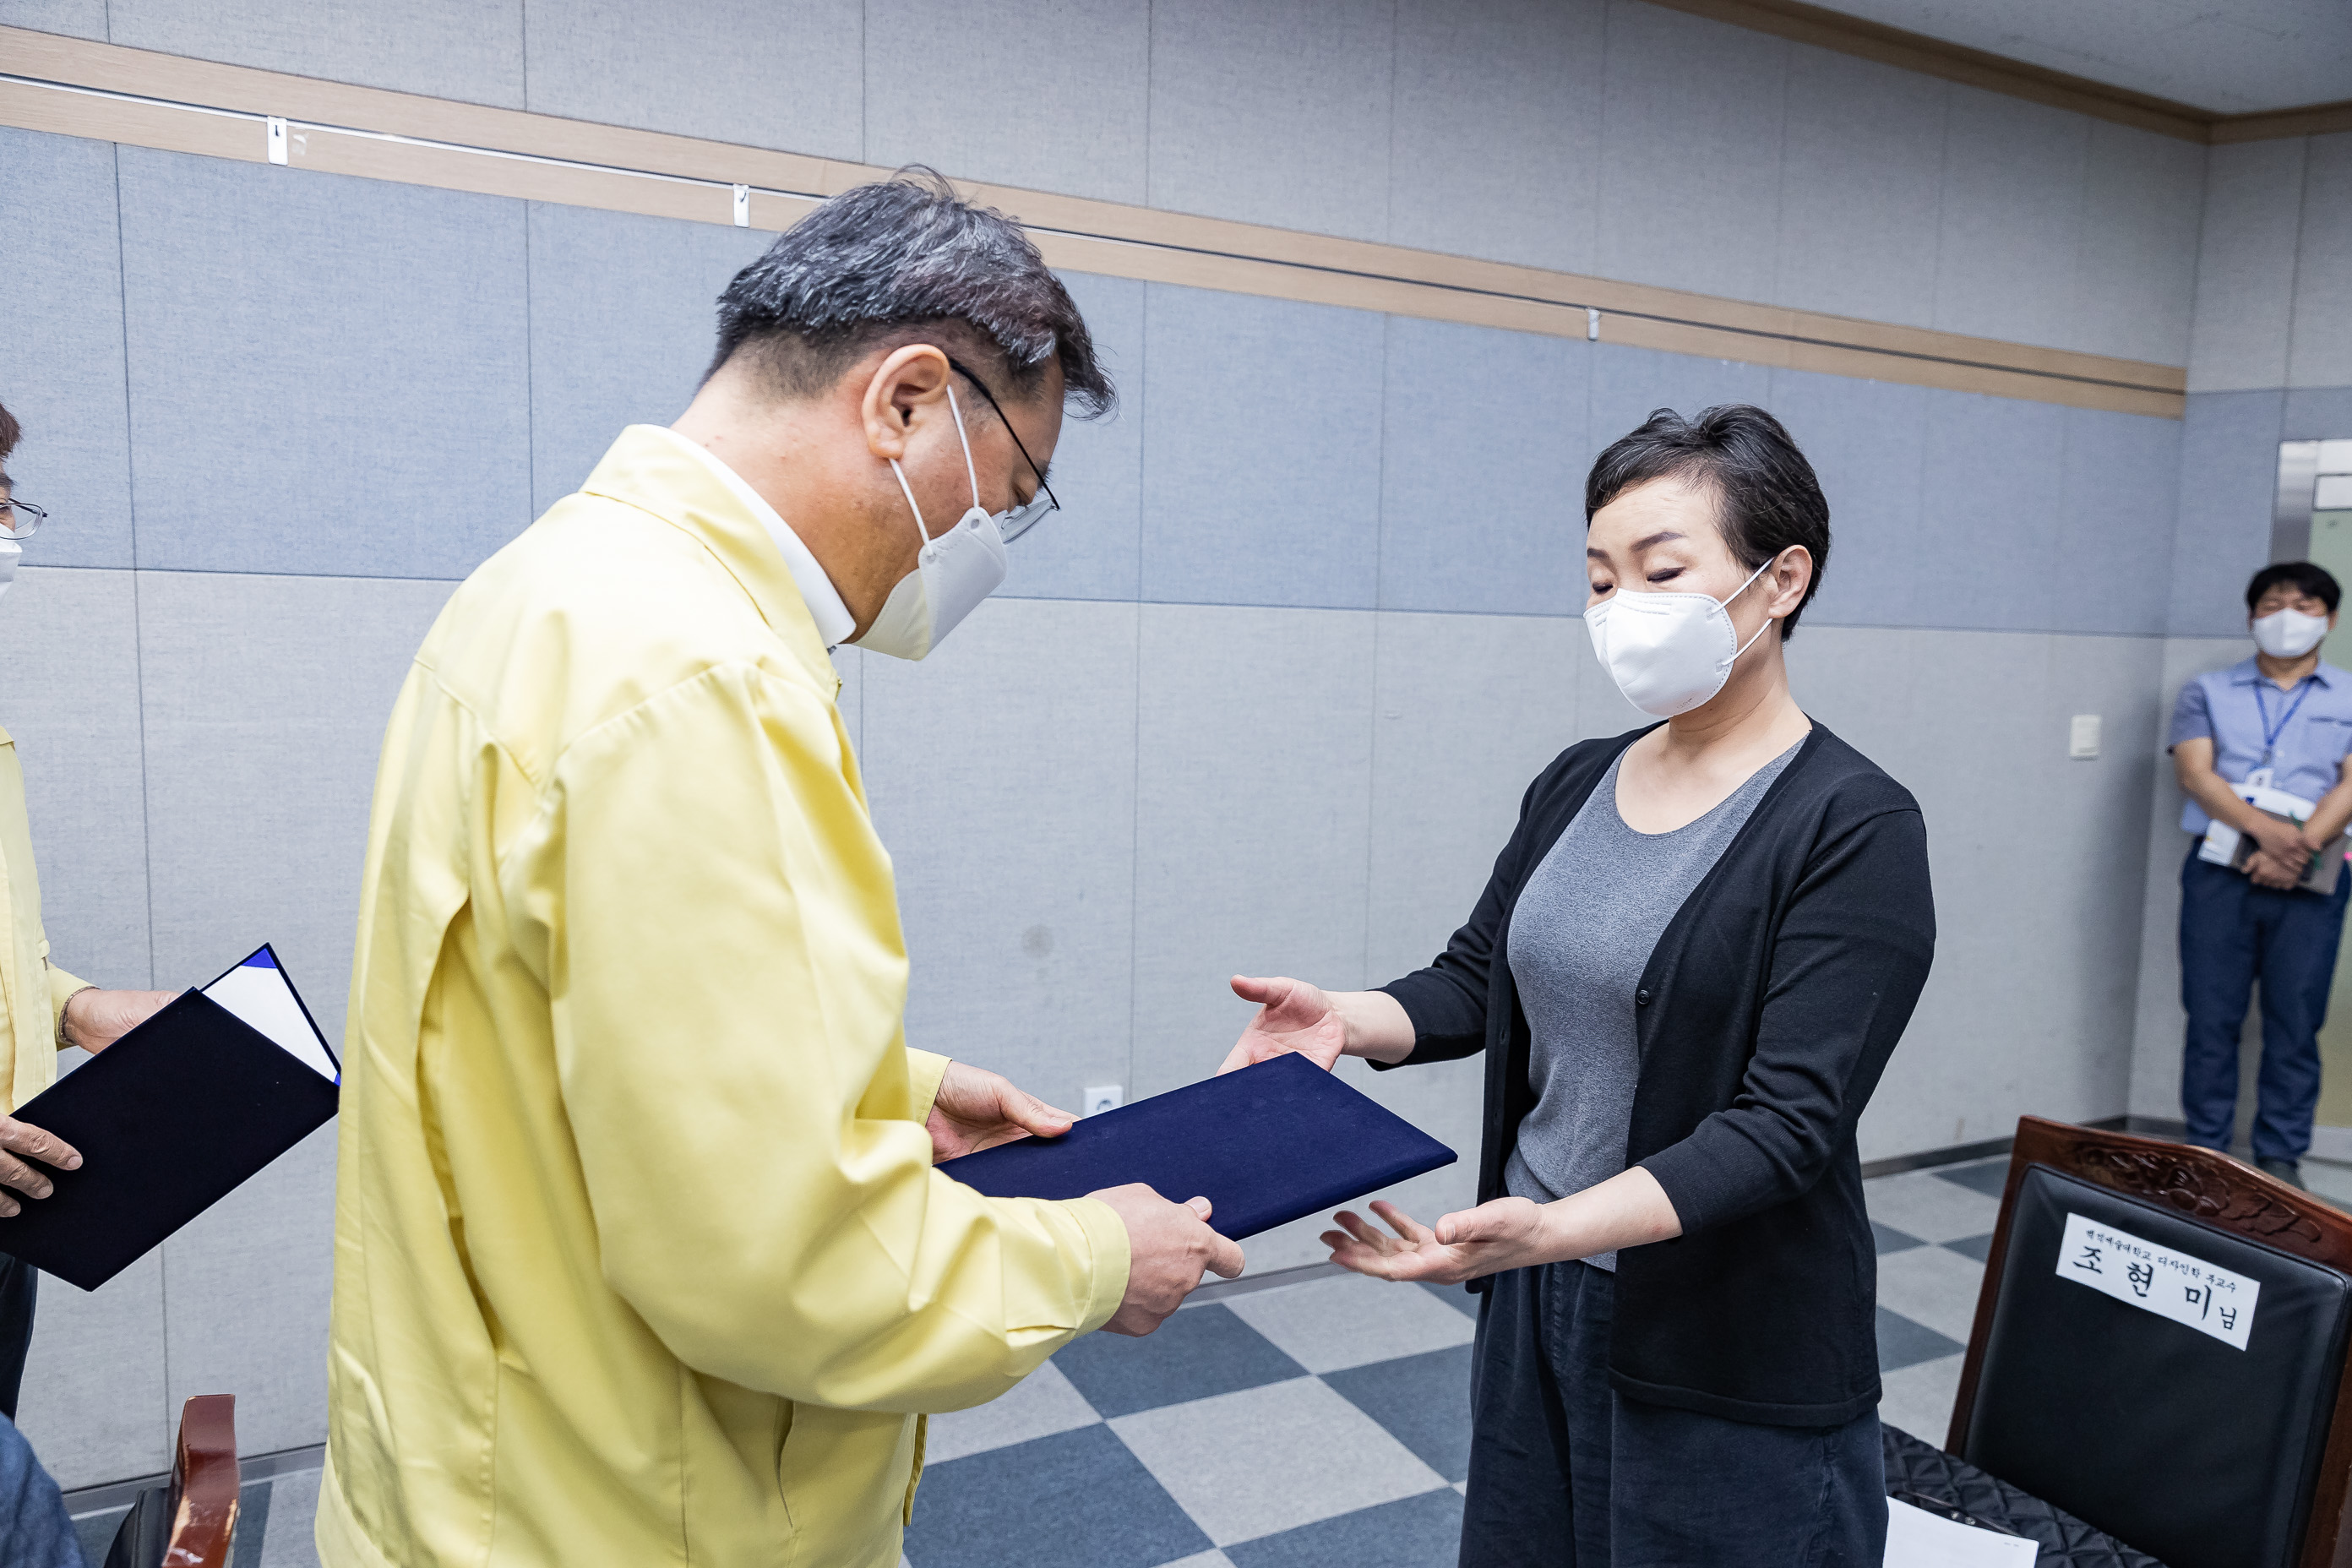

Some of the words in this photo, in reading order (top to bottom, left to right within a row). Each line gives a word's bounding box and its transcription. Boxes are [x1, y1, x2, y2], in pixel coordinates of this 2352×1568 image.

[2072, 1245, 2104, 1275] 조
[2126, 1261, 2153, 1298] 현
[2184, 1284, 2212, 1320] 미
[2219, 1306, 2237, 1331] 님
